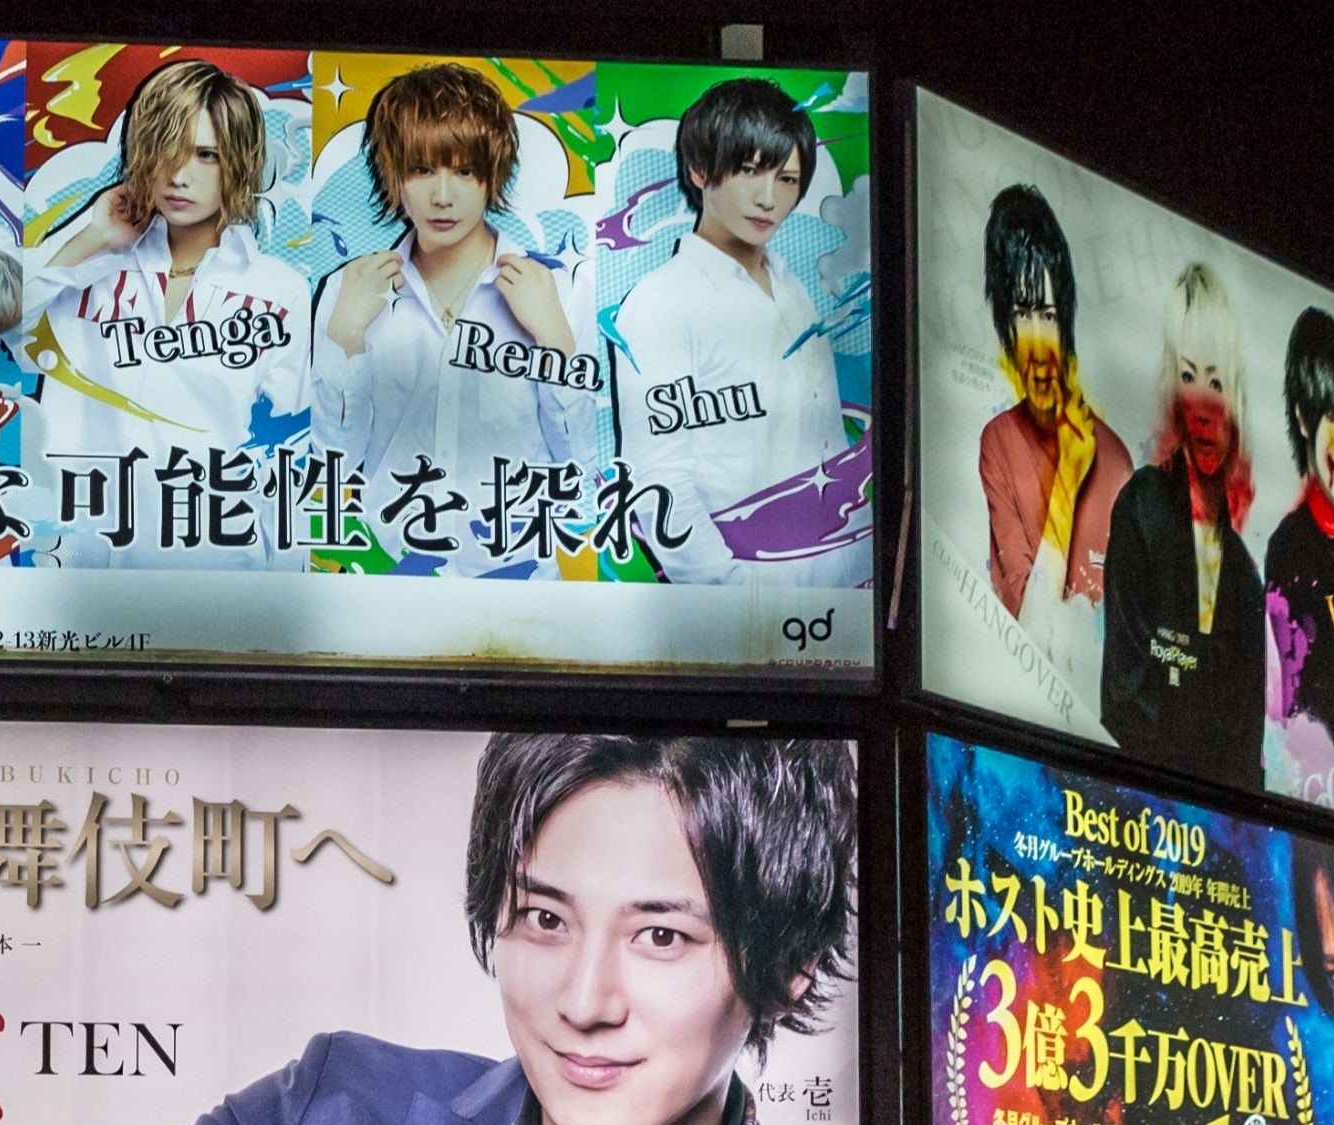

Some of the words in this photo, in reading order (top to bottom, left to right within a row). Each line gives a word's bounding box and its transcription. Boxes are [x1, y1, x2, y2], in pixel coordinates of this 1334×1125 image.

[100, 307, 291, 370] Tenga
[450, 317, 605, 392] Rena
[646, 374, 767, 435] Shu
[958, 569, 1077, 724] HANGOVER
[1064, 789, 1119, 849] Best
[1123, 807, 1151, 856] of
[1153, 815, 1206, 867] 2019
[1013, 831, 1167, 889] 冬月グループホールディングス
[1205, 878, 1252, 912] 年間売上
[944, 857, 1310, 1008] ホスト史上最高売上
[20, 1018, 184, 1078] TEN
[977, 959, 1291, 1121] 3億3千万OVER
[757, 1082, 795, 1105] 代表
[802, 1075, 833, 1109] 壱
[805, 1107, 832, 1122] Ichi
